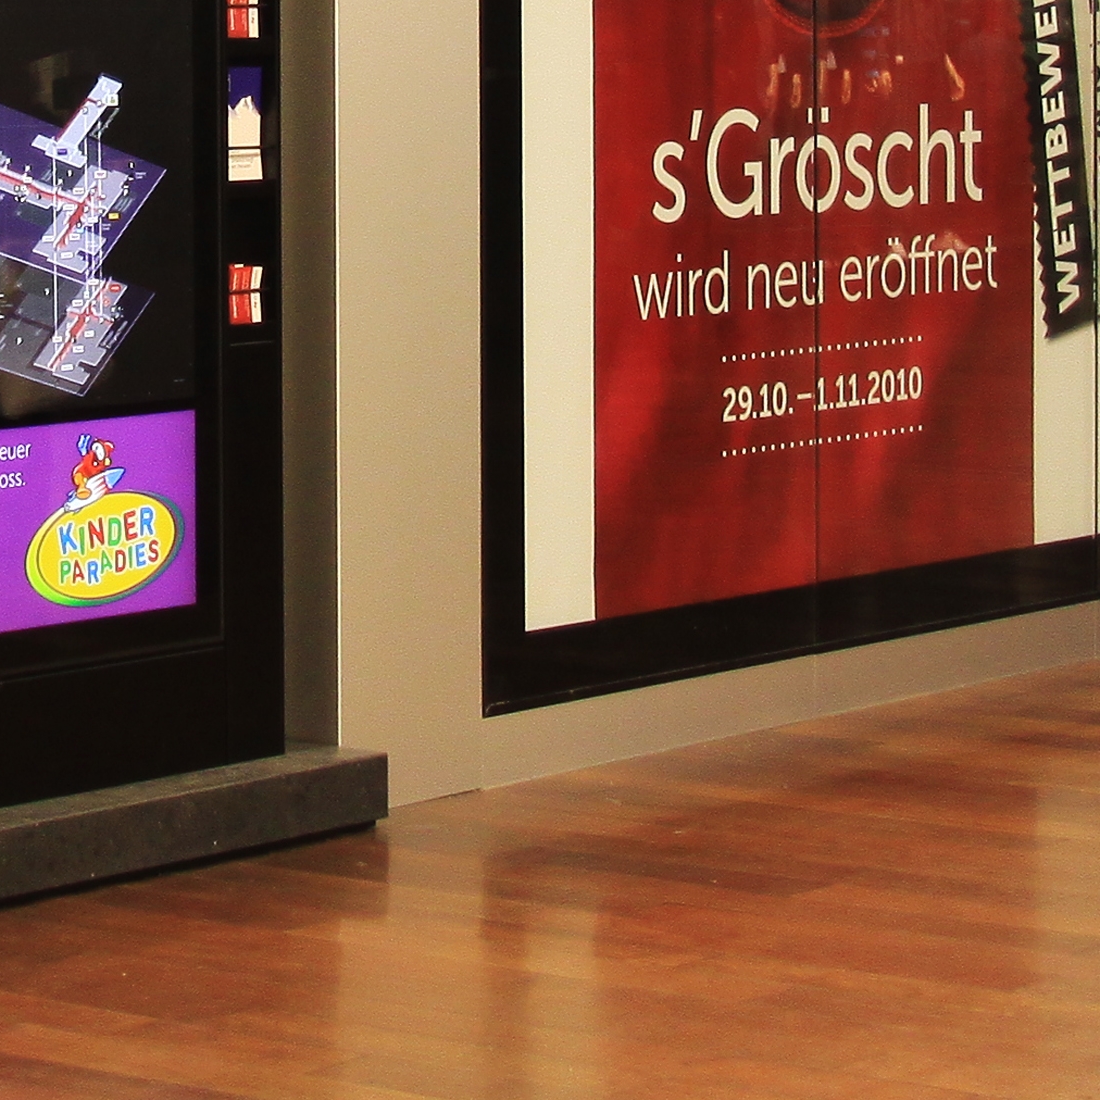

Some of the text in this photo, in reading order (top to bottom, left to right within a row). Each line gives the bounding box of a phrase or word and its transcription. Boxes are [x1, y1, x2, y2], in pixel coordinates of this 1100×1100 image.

[651, 102, 984, 224] s'Gröscht
[633, 235, 999, 321] wird neu eröffnet
[58, 506, 155, 556] KINDER
[59, 538, 161, 585] PARADIES
